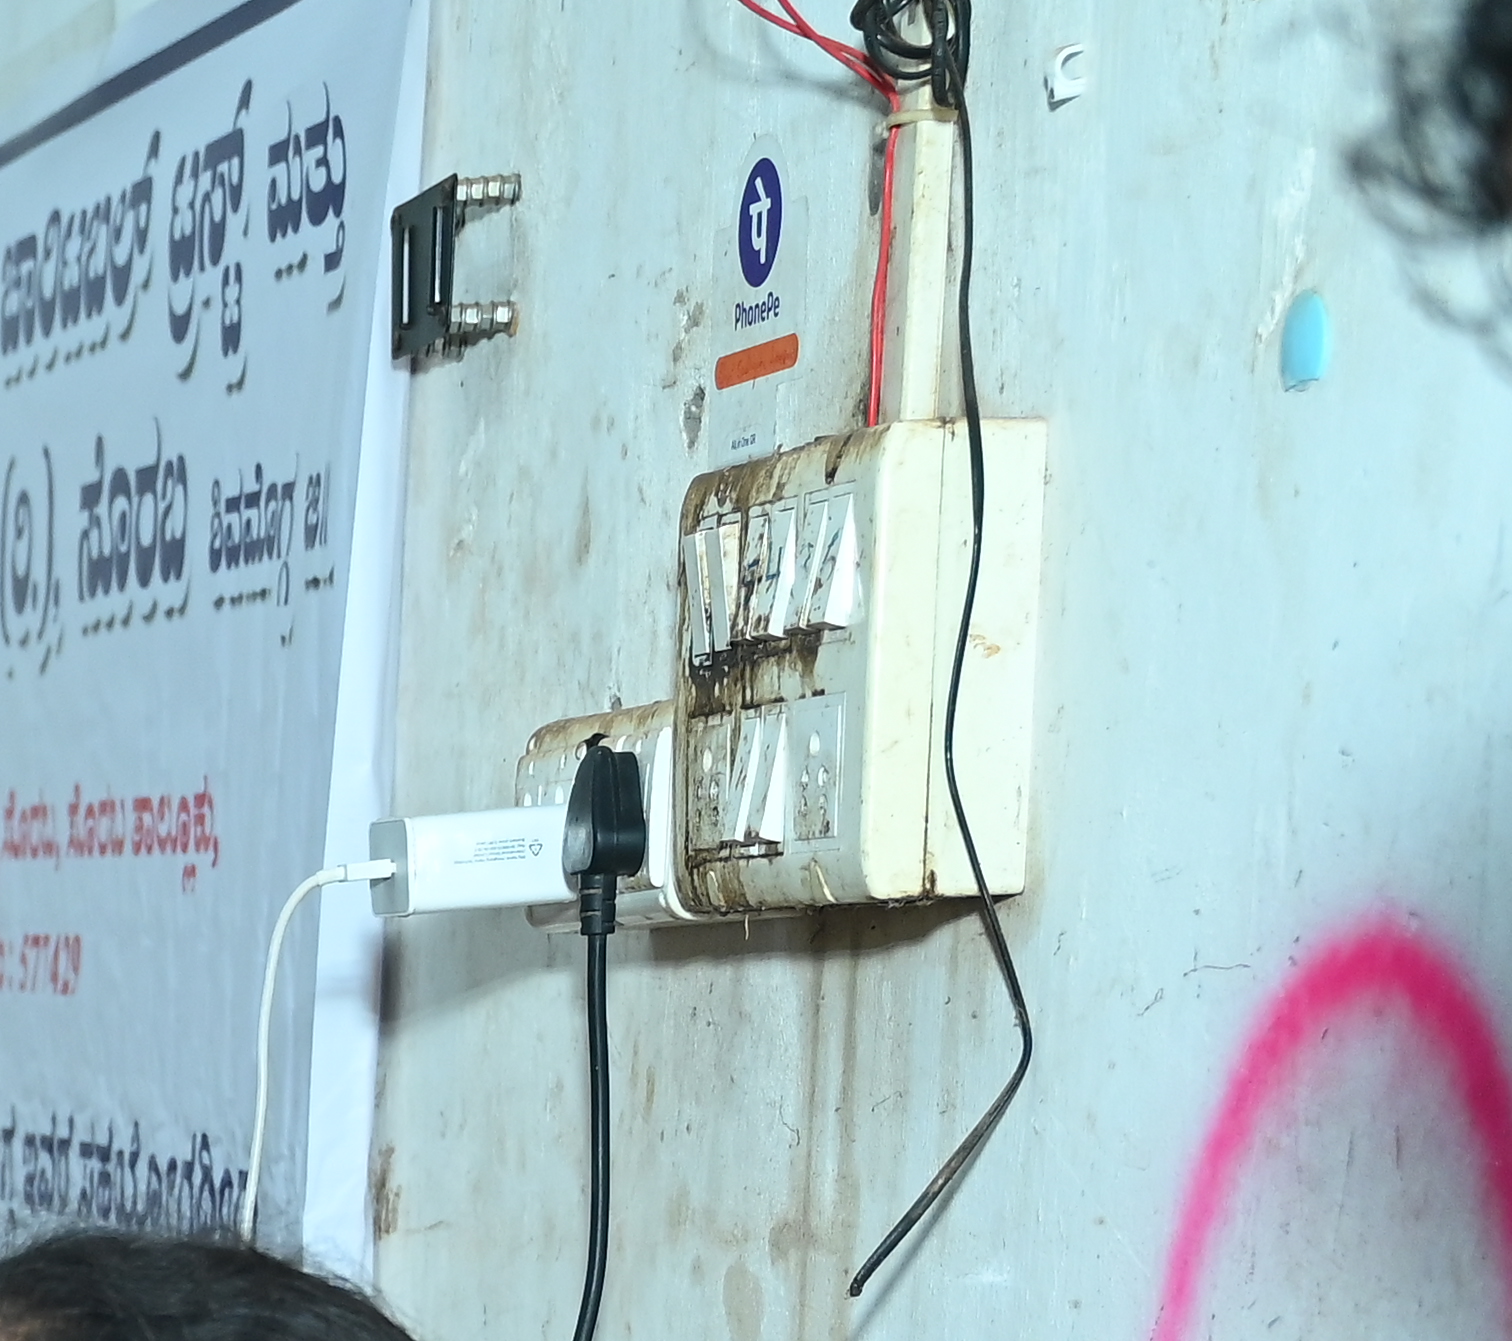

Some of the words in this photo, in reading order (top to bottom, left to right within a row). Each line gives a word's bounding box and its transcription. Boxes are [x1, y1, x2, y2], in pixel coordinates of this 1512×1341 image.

[267, 80, 347, 274] ಮತ್ತು
[734, 291, 780, 331] PhonePe
[77, 416, 188, 601] ಸೊರಬ
[208, 451, 299, 606] ಶಿವಮೊಗ್ಗ
